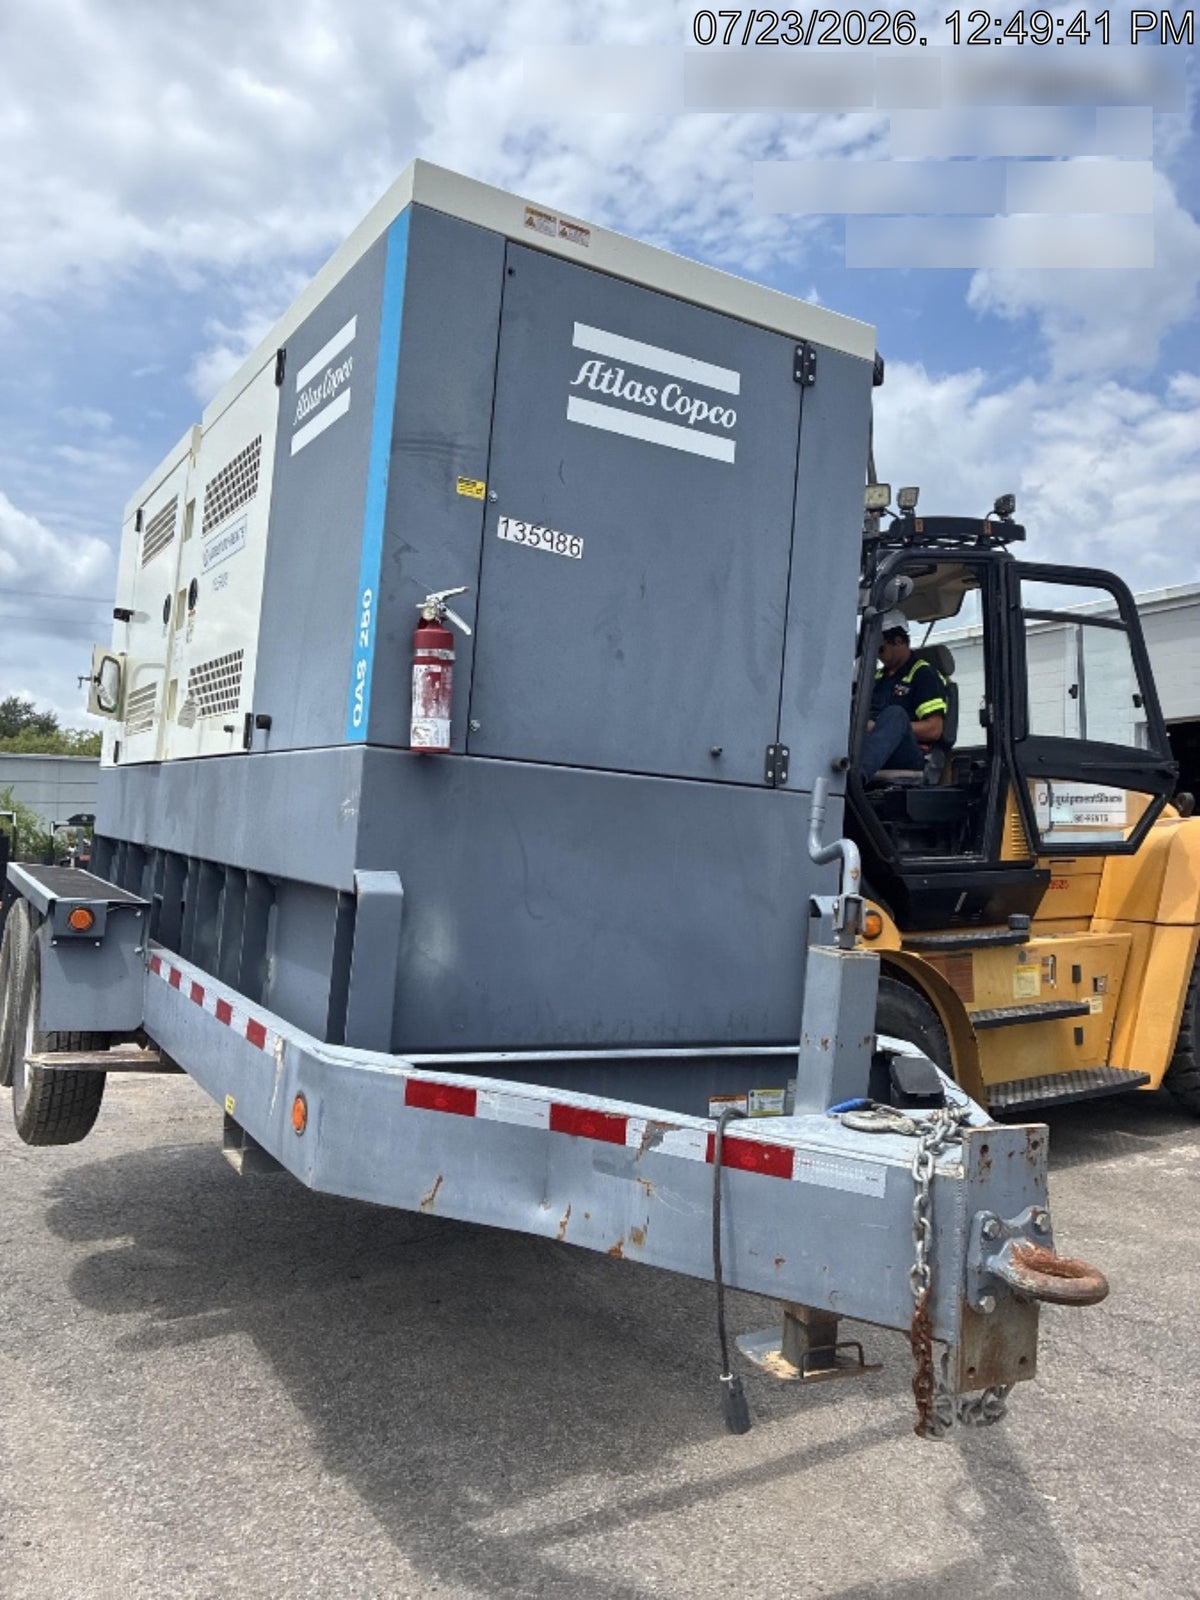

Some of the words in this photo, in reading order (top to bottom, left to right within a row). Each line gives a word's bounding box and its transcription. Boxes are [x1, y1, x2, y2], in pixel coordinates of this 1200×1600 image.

[570, 360, 658, 406] Atlas
[661, 383, 737, 428] Copco
[501, 518, 580, 557] 135986
